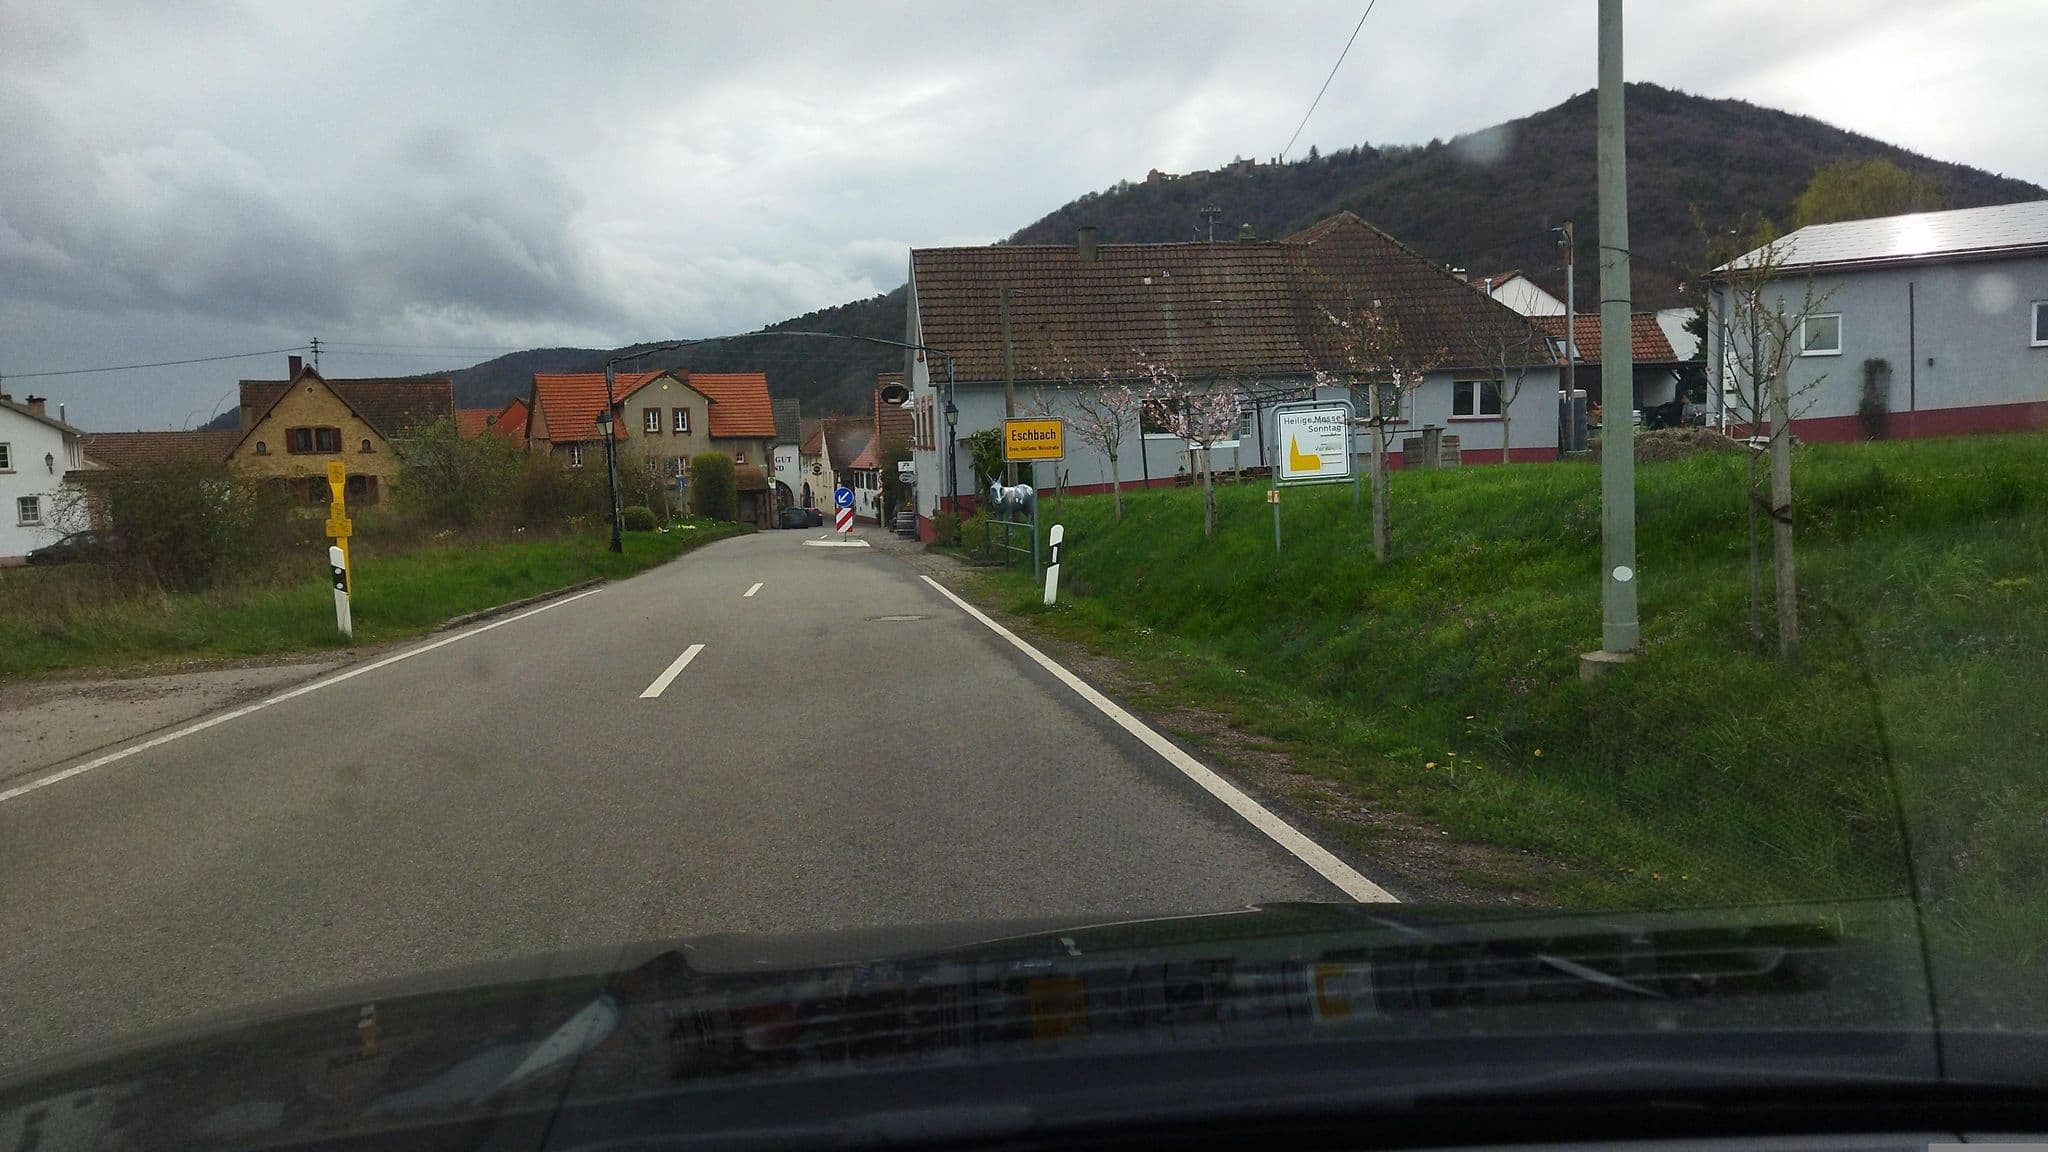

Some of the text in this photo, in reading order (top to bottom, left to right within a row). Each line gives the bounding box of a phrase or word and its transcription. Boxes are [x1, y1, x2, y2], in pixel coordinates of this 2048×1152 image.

[1283, 417, 1312, 425] Heilige
[1308, 425, 1342, 433] Sonntag
[1011, 428, 1056, 441] Eschbach
